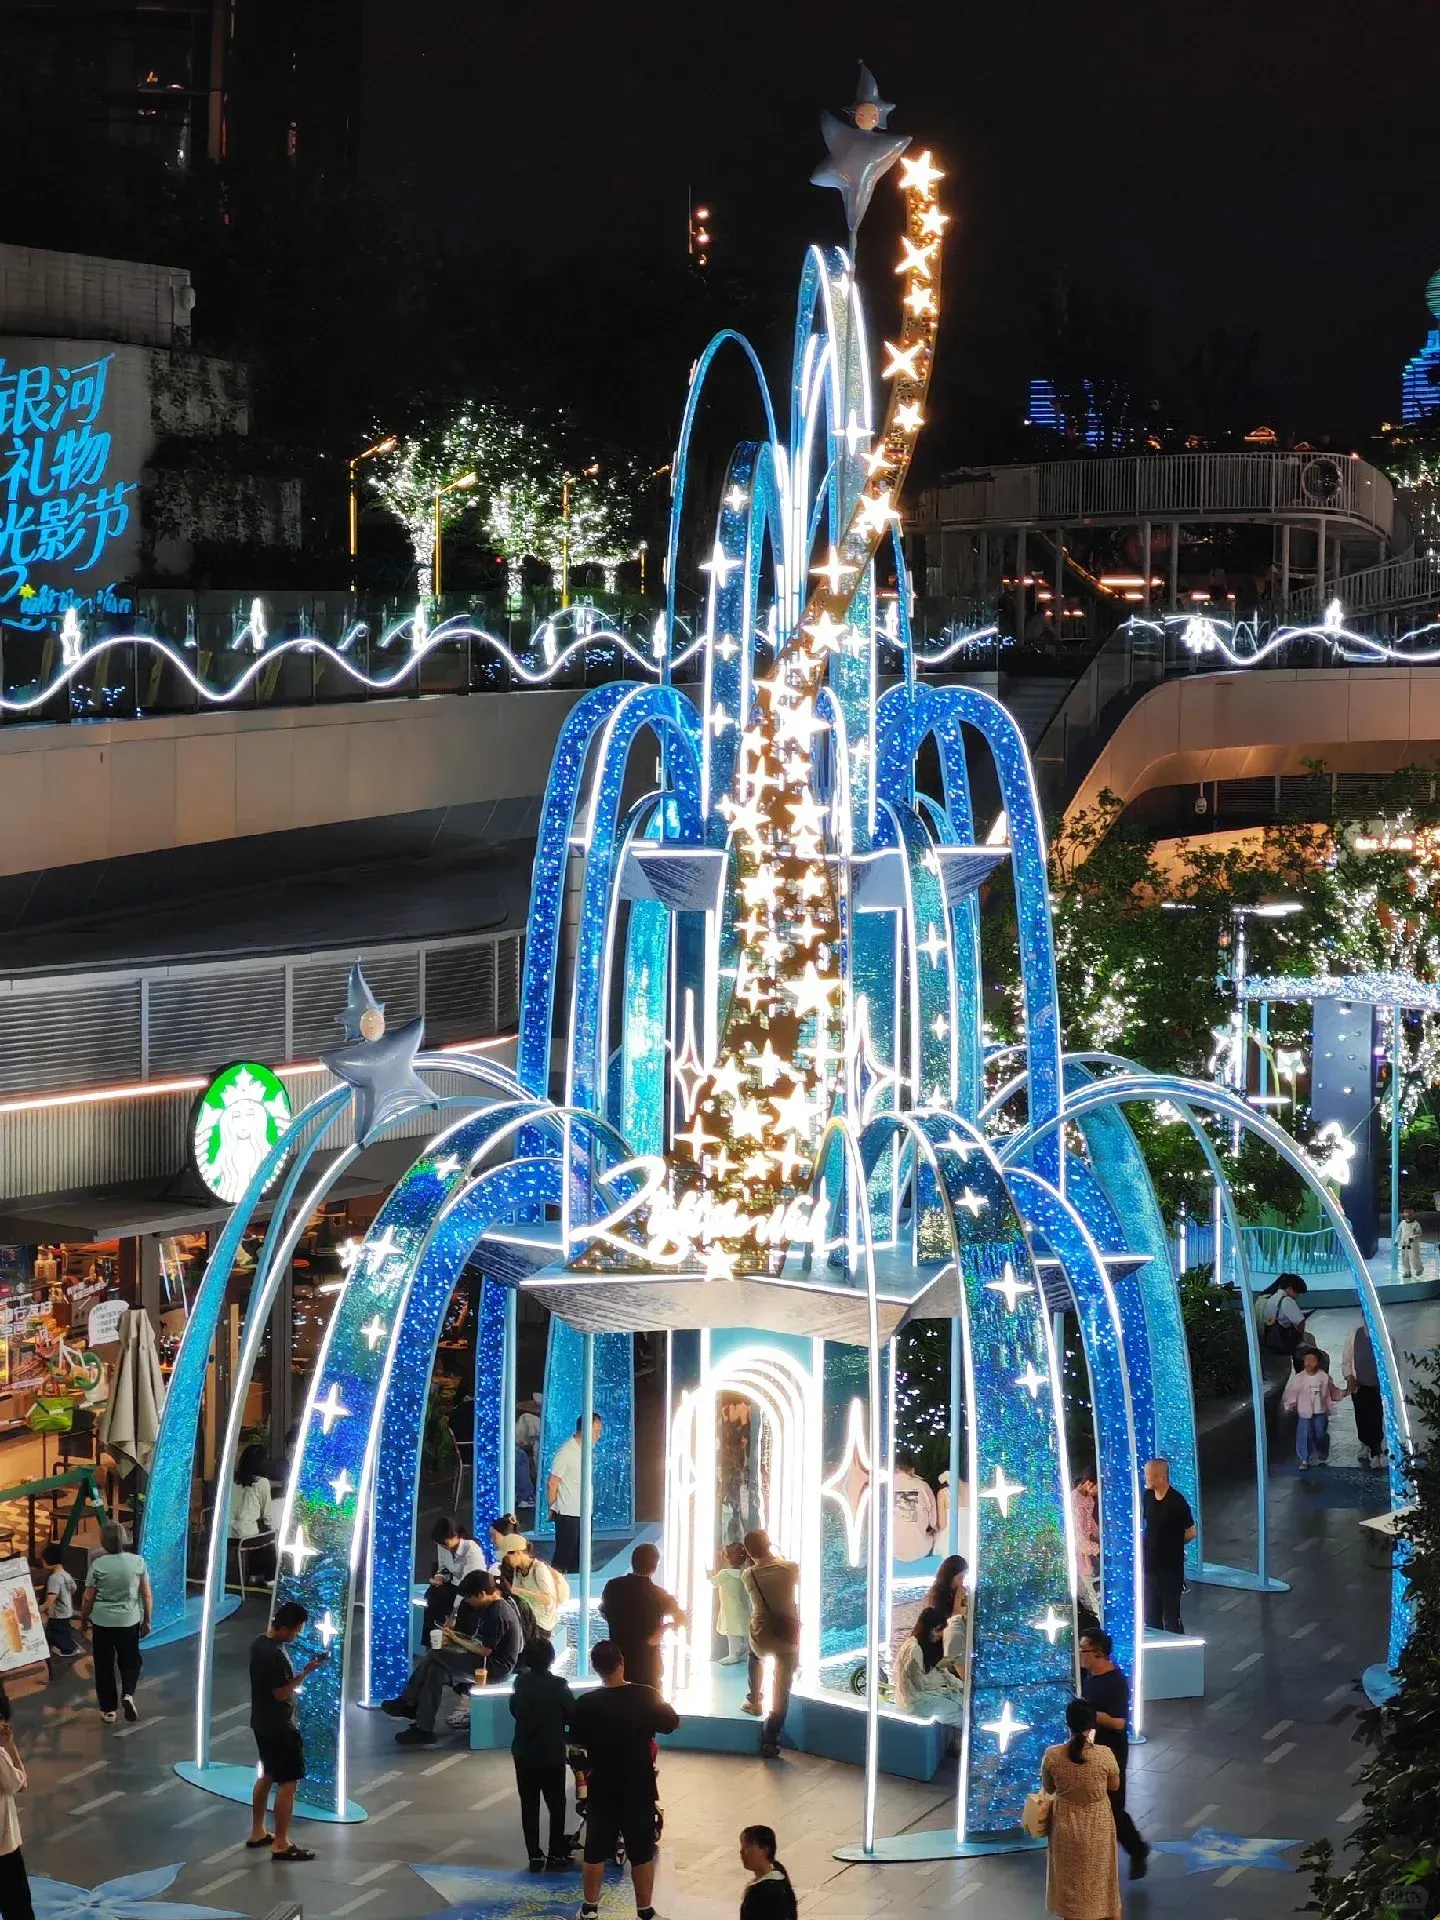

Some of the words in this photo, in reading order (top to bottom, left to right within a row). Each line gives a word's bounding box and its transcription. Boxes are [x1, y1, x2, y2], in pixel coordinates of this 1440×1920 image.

[0, 353, 116, 431] 银河
[0, 425, 111, 500] 礼物
[0, 482, 141, 571] 光影节
